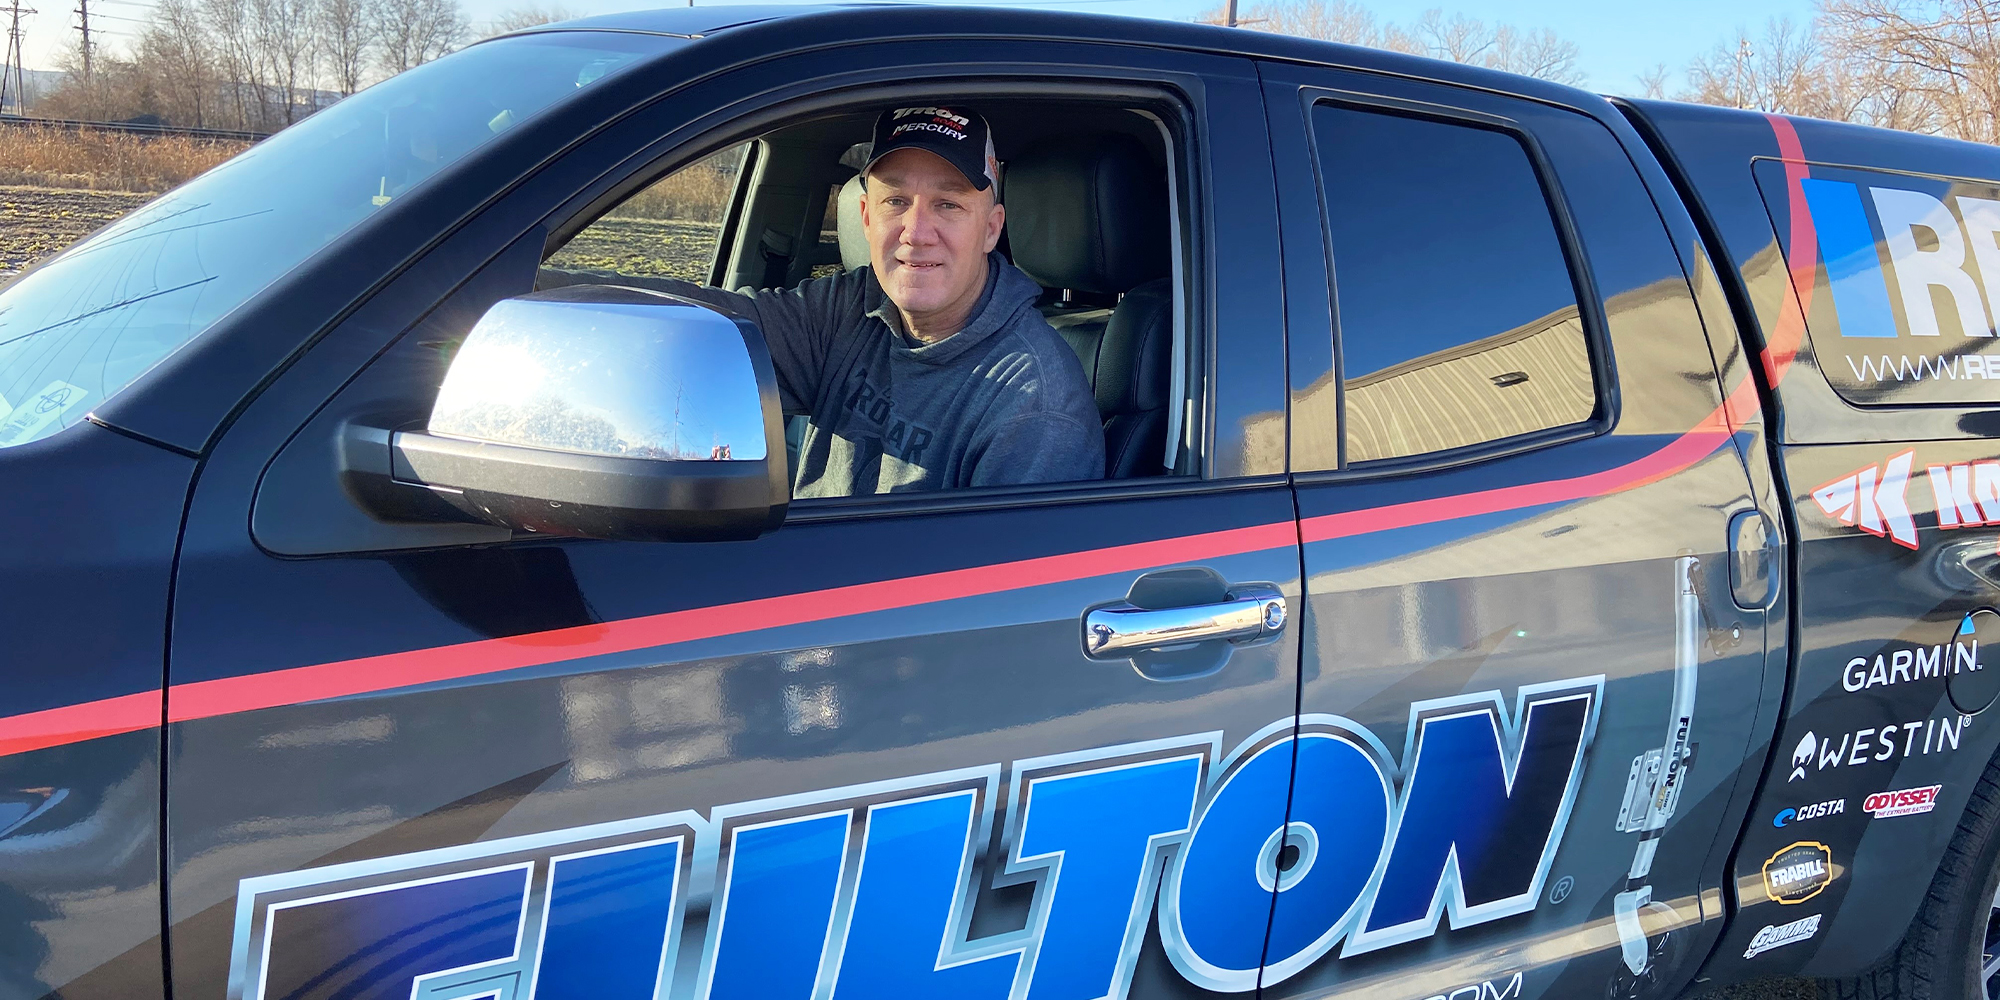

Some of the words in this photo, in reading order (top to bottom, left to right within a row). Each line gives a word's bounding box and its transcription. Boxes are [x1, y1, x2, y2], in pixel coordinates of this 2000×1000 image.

[893, 123, 968, 140] MERCURY
[1842, 640, 1978, 692] GARMIN
[1796, 799, 1845, 821] COSTA
[1864, 786, 1940, 811] ODYSSEY
[1770, 858, 1826, 888] FRABILL
